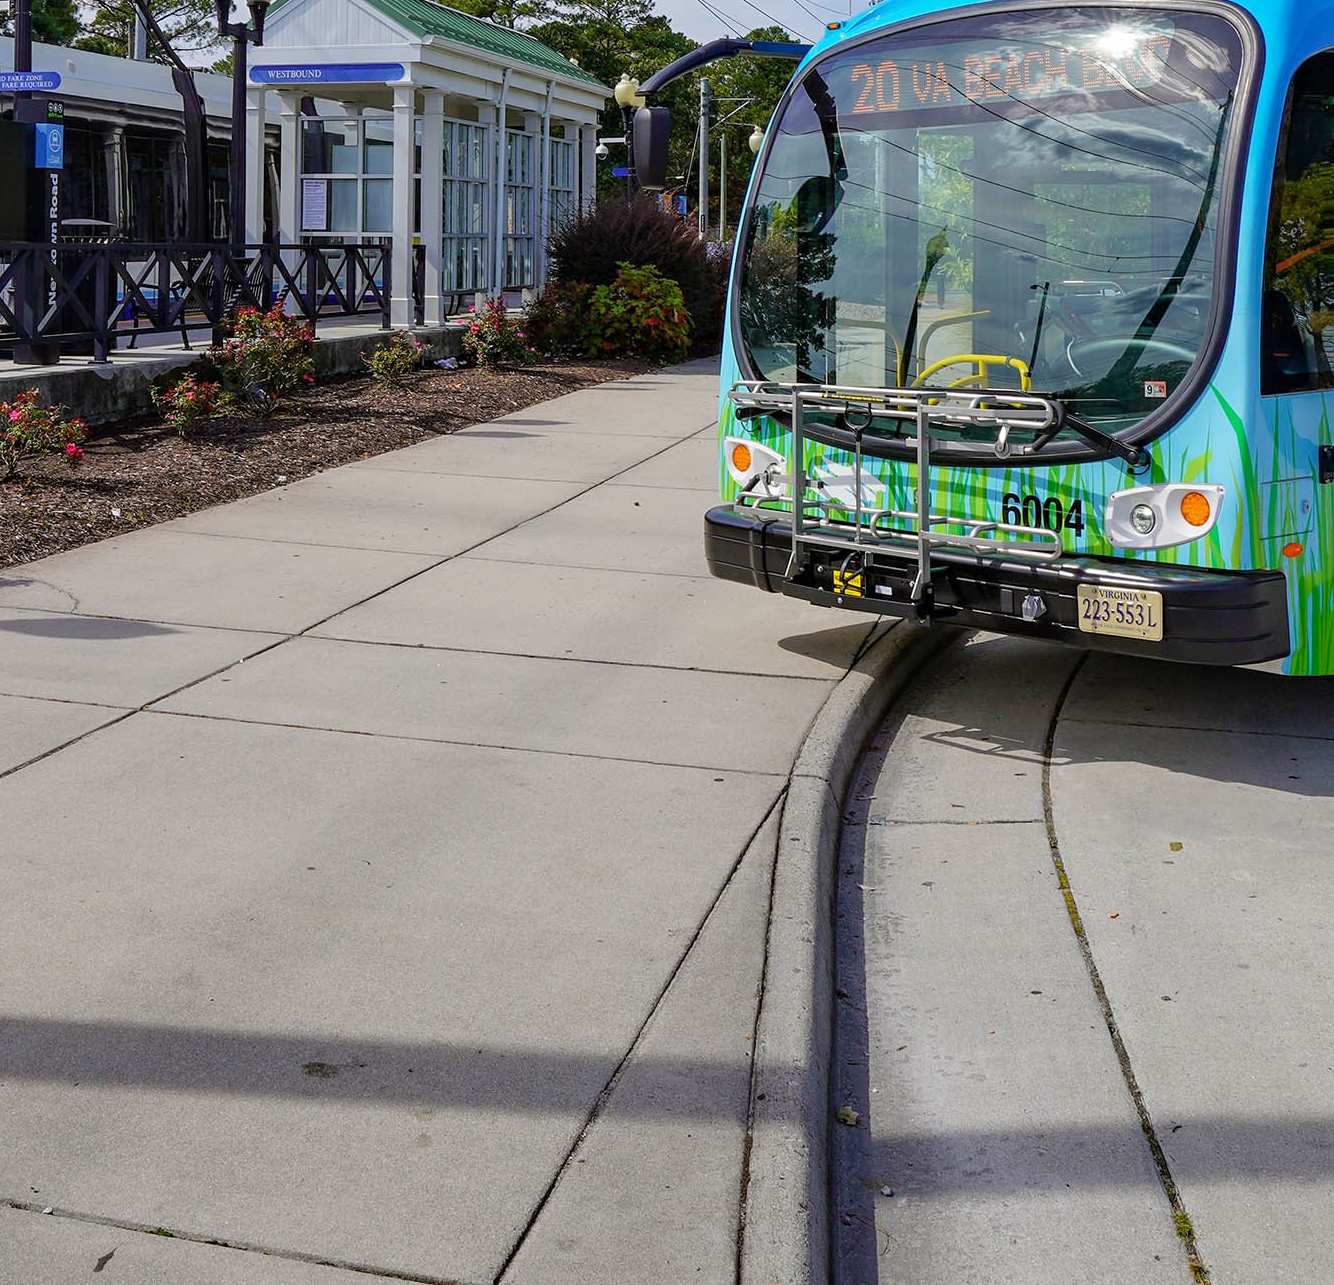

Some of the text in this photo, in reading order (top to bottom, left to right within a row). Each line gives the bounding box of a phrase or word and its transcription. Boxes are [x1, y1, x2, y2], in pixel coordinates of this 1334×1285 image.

[20, 81, 54, 89] REQUIRED
[267, 69, 322, 79] WESTBOUND
[851, 60, 900, 113] 20
[912, 61, 951, 104] VA
[964, 48, 1067, 99] BEACH
[49, 173, 59, 219] Road
[1002, 492, 1085, 538] 6004
[1099, 589, 1140, 602] VIRGINIA
